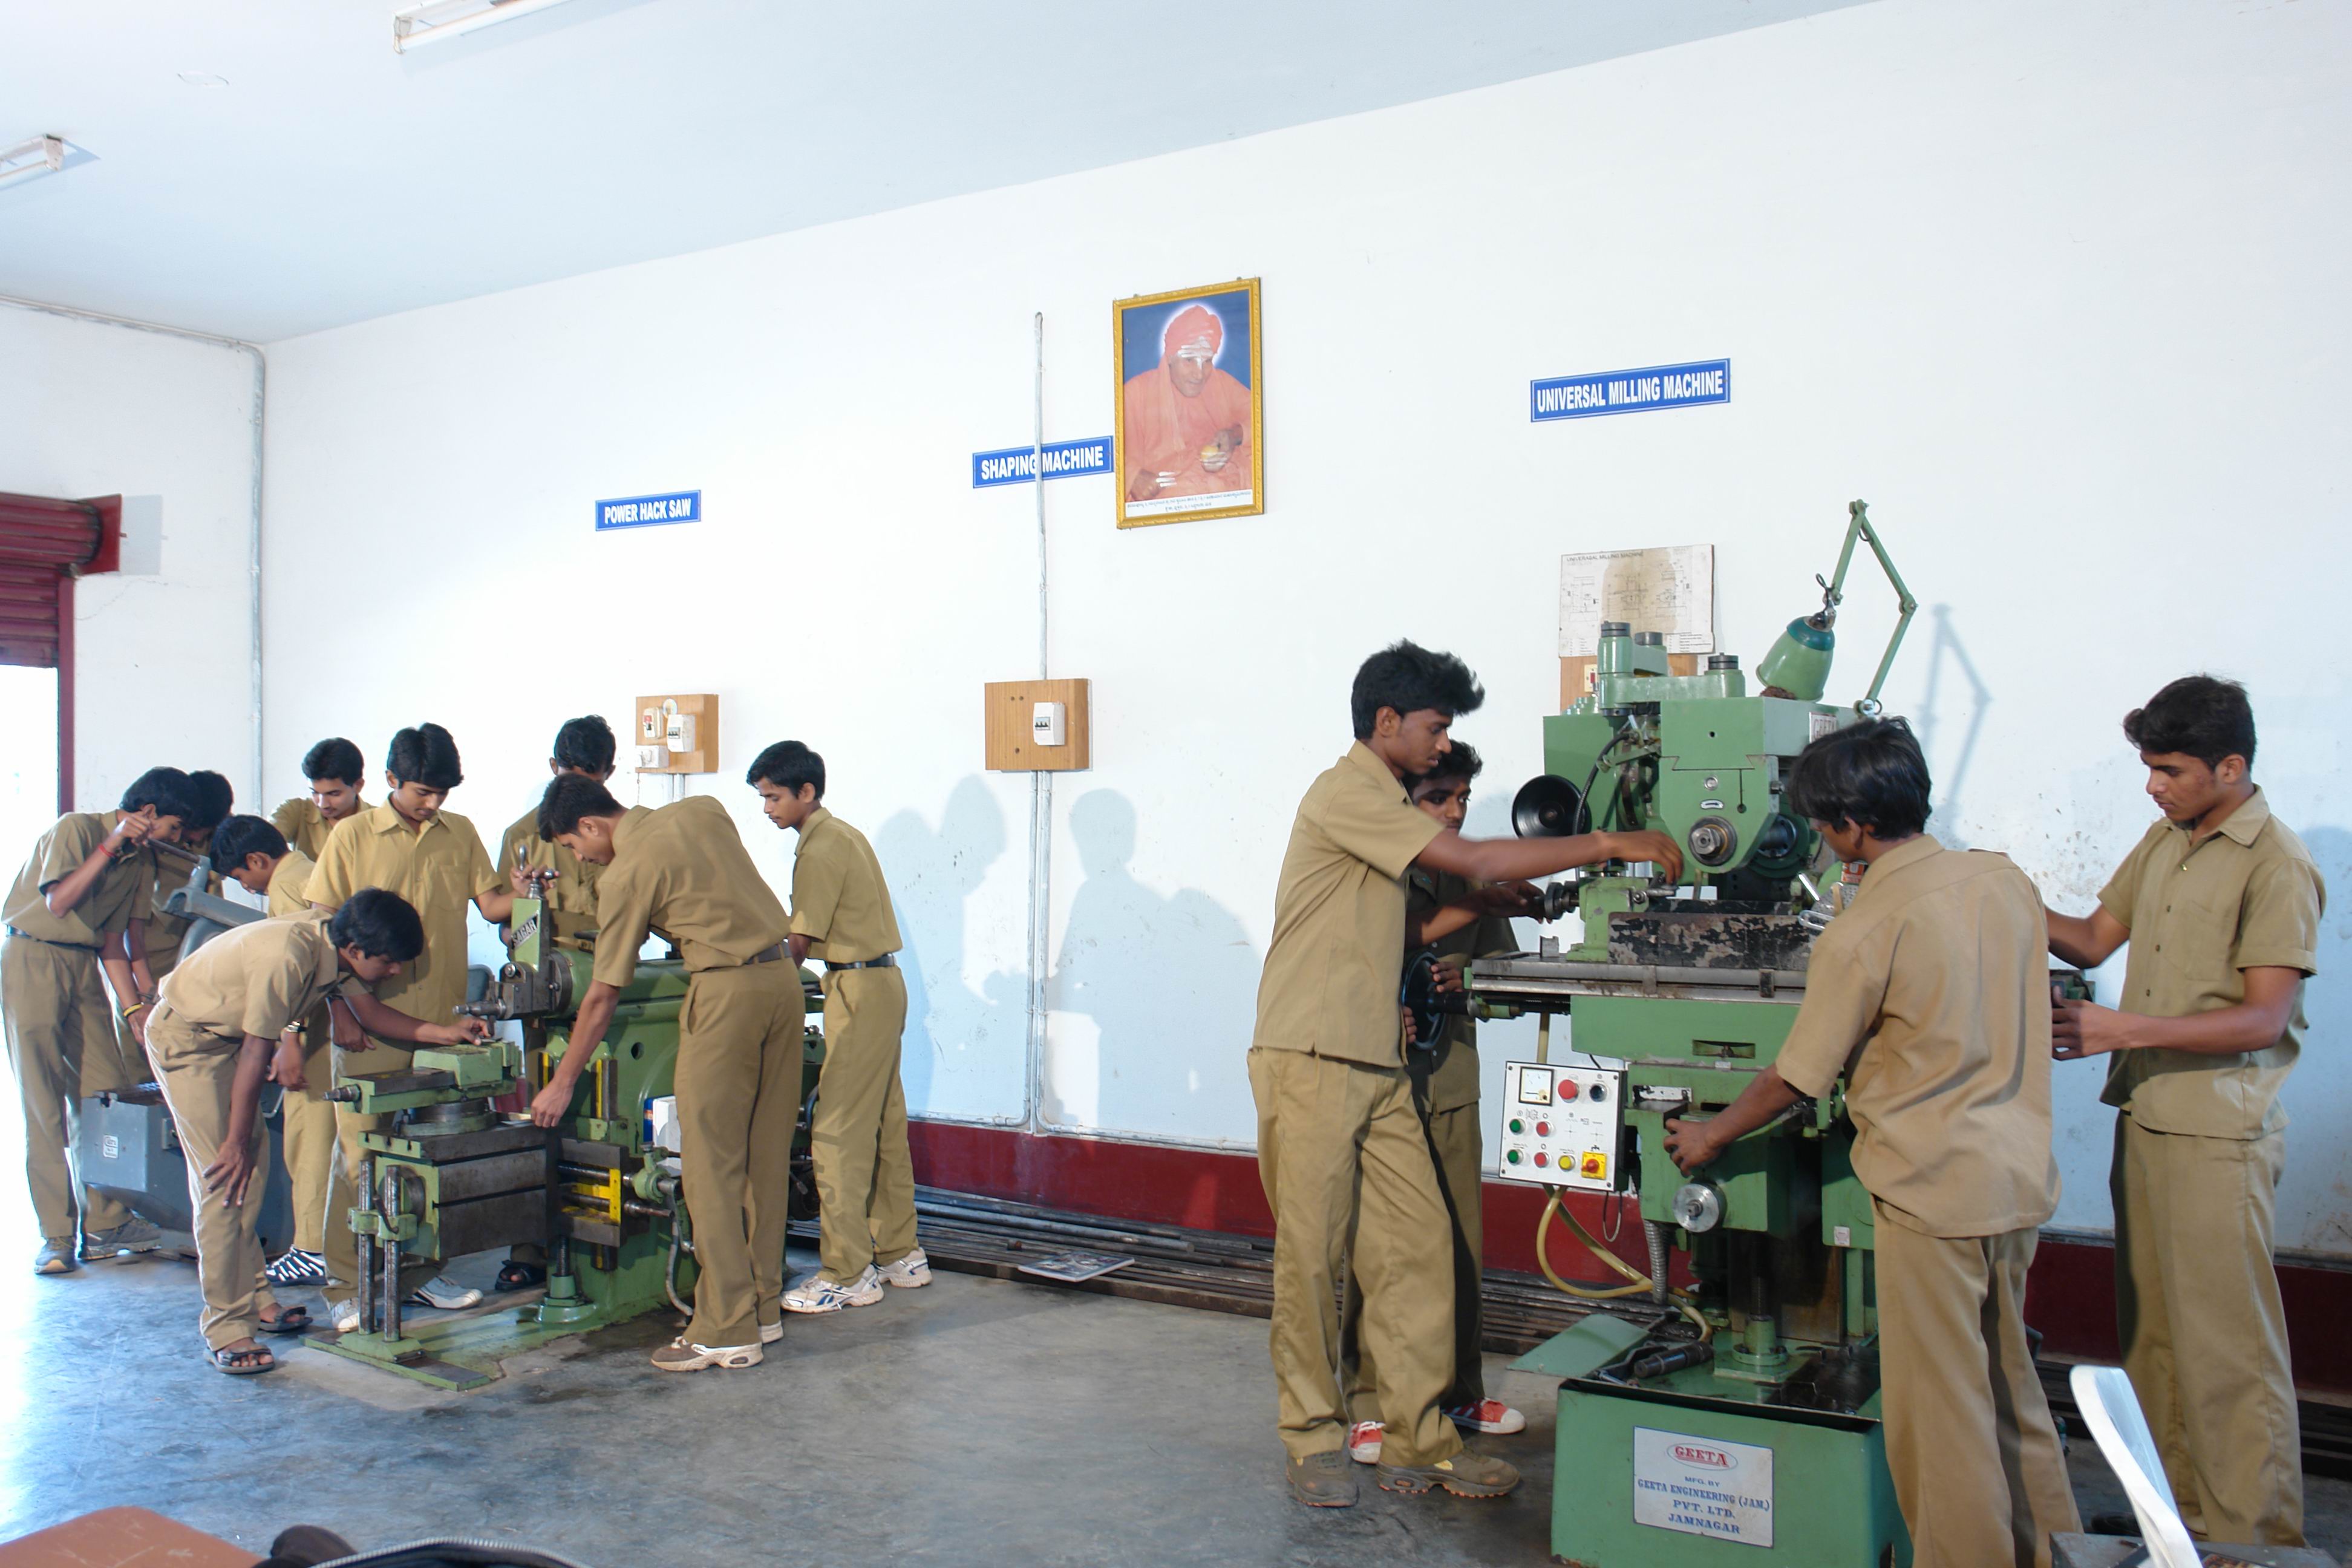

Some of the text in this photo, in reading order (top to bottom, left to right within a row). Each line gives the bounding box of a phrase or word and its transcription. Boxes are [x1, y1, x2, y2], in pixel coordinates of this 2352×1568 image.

[1537, 370, 1723, 413] UNIVERSAL MILLING MACHINE
[981, 445, 1104, 480] SHAPING MACHINE
[604, 498, 691, 524] POWER HACK SAW
[1674, 1446, 1730, 1467] GEETA
[1638, 1478, 1668, 1492] GEETA
[1670, 1484, 1736, 1504] ENGINEERING
[1673, 1499, 1736, 1519] PVT. LTD.
[1668, 1513, 1740, 1535] JAMNAGAR
